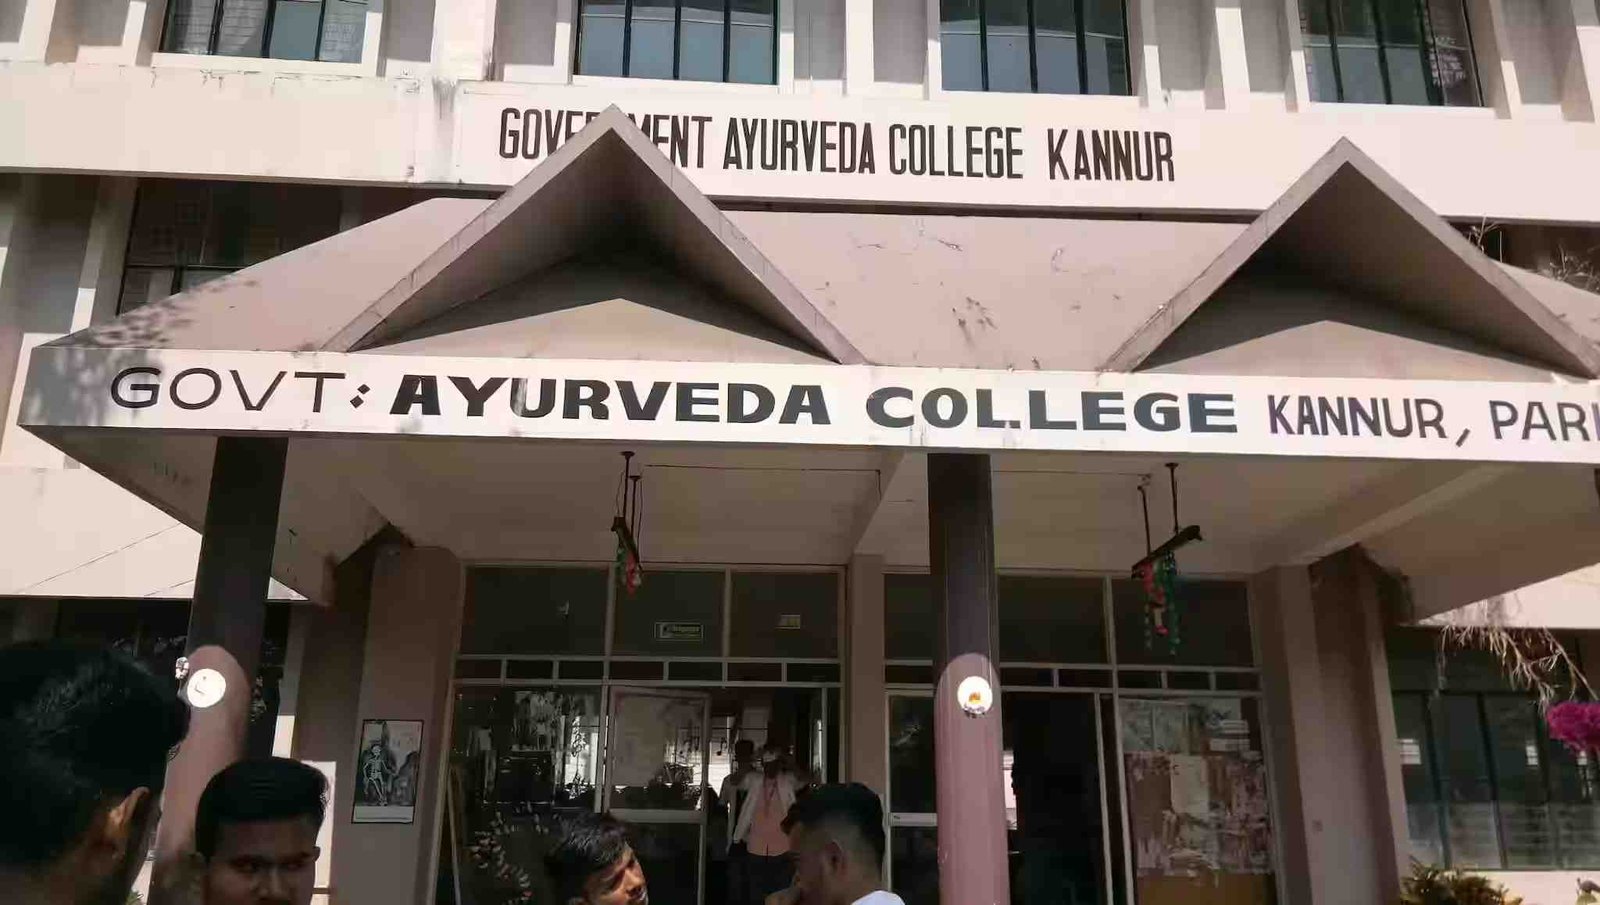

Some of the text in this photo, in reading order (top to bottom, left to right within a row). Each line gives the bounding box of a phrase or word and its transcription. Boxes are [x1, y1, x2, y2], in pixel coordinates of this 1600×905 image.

[723, 117, 876, 174] AYURVEDA
[888, 123, 1024, 179] COLLEGE
[1047, 128, 1175, 182] KANNUR
[110, 366, 371, 413] GOVT:
[390, 375, 831, 425] AYURVEDA
[865, 386, 1238, 433] COLLEGE
[1268, 395, 1471, 447] KANNUR,
